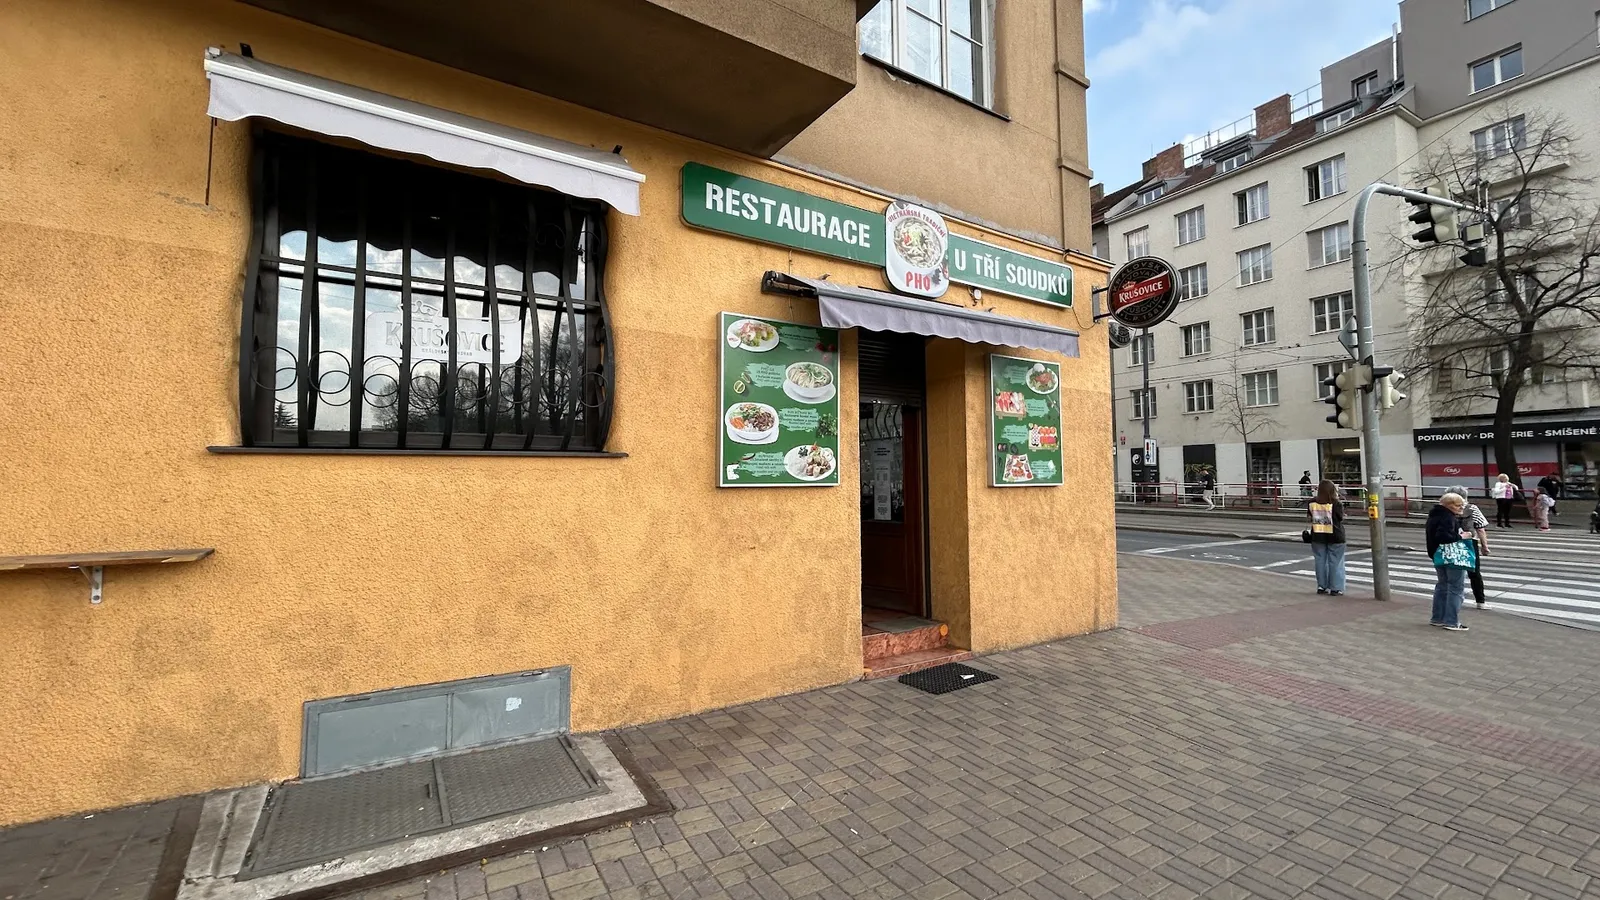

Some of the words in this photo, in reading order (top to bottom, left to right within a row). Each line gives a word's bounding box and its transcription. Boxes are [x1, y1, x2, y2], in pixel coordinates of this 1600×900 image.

[705, 182, 871, 249] RESTAURACE
[905, 270, 932, 292] PHO
[954, 248, 966, 271] U
[972, 253, 1001, 280] TŘÍ
[1005, 262, 1068, 297] SOUDKŮ
[1118, 280, 1164, 303] KRUŠOVICE
[1417, 433, 1471, 442] POTRAVINY
[1479, 430, 1534, 440] DRERIE
[1544, 427, 1597, 437] SMÍŠENÉ
